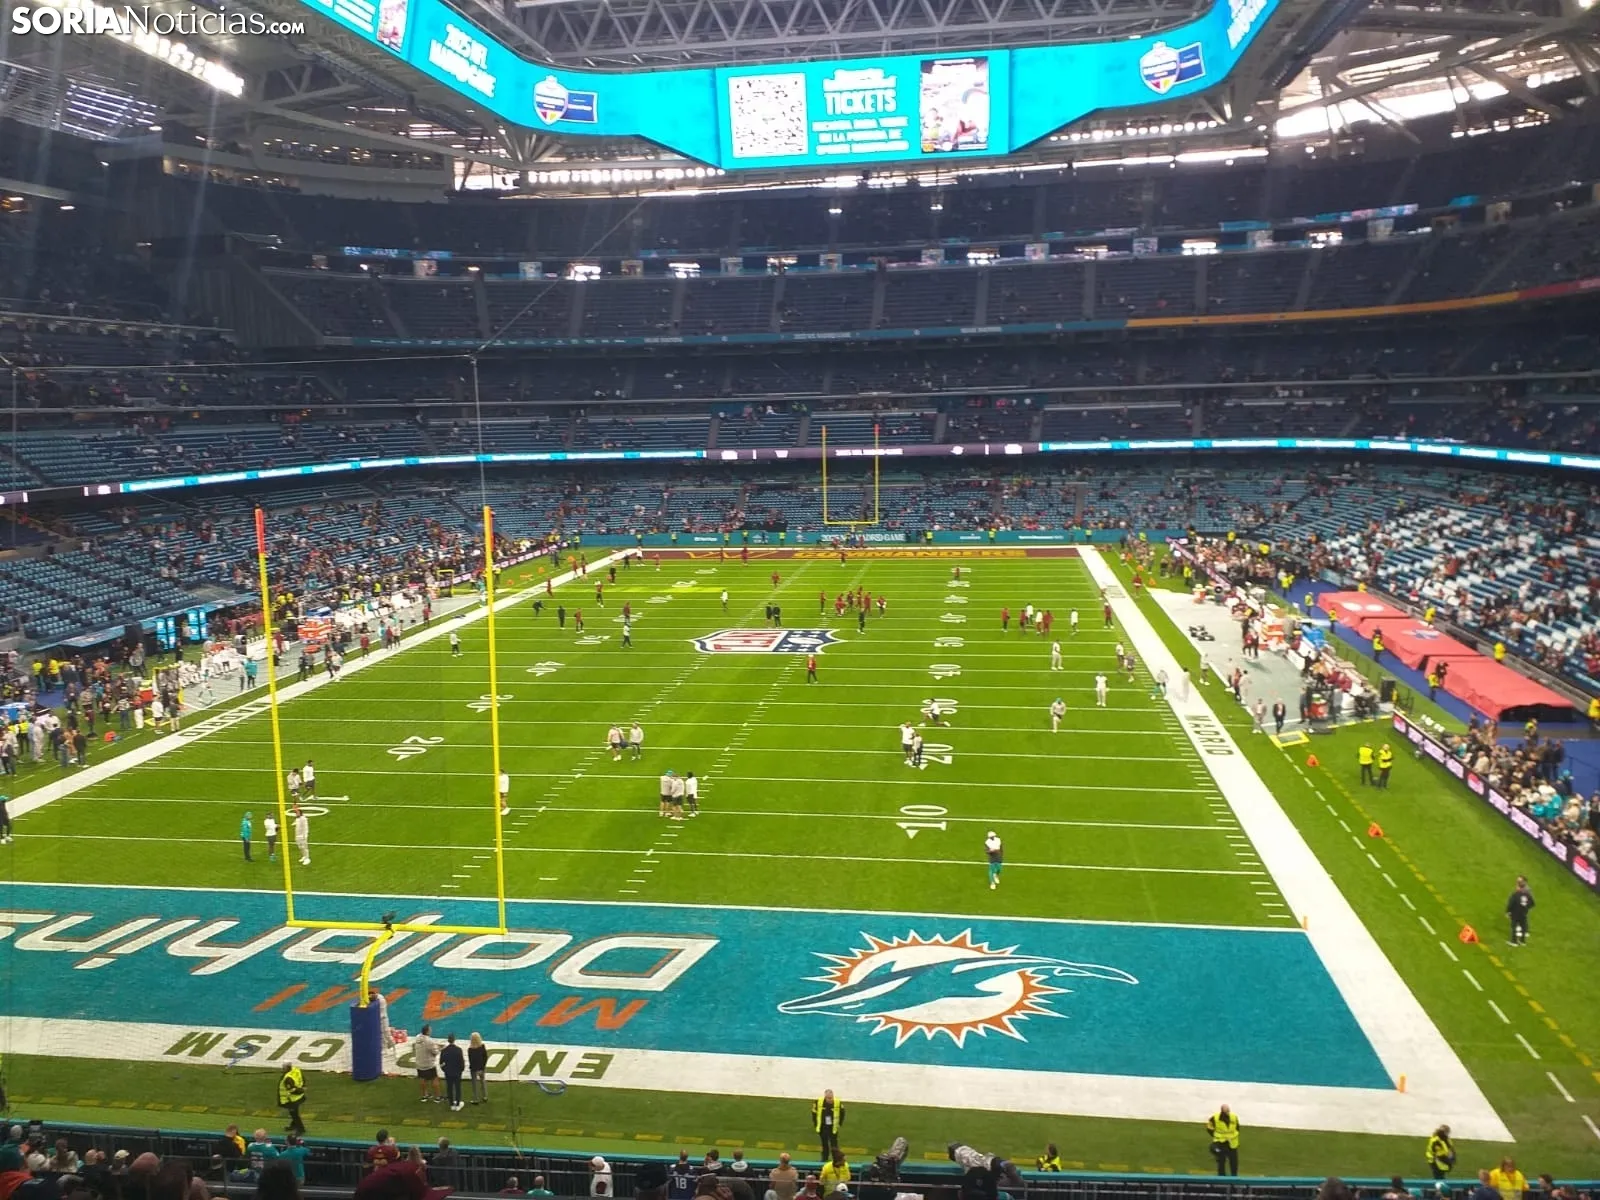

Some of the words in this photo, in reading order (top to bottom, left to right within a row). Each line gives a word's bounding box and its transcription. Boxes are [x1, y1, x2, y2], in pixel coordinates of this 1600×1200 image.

[824, 89, 897, 115] TICKETS
[386, 735, 445, 756] 20
[1184, 714, 1235, 756] MADRID
[895, 804, 948, 832] 10
[252, 984, 648, 1030] MIAMI
[486, 1047, 615, 1080] END
